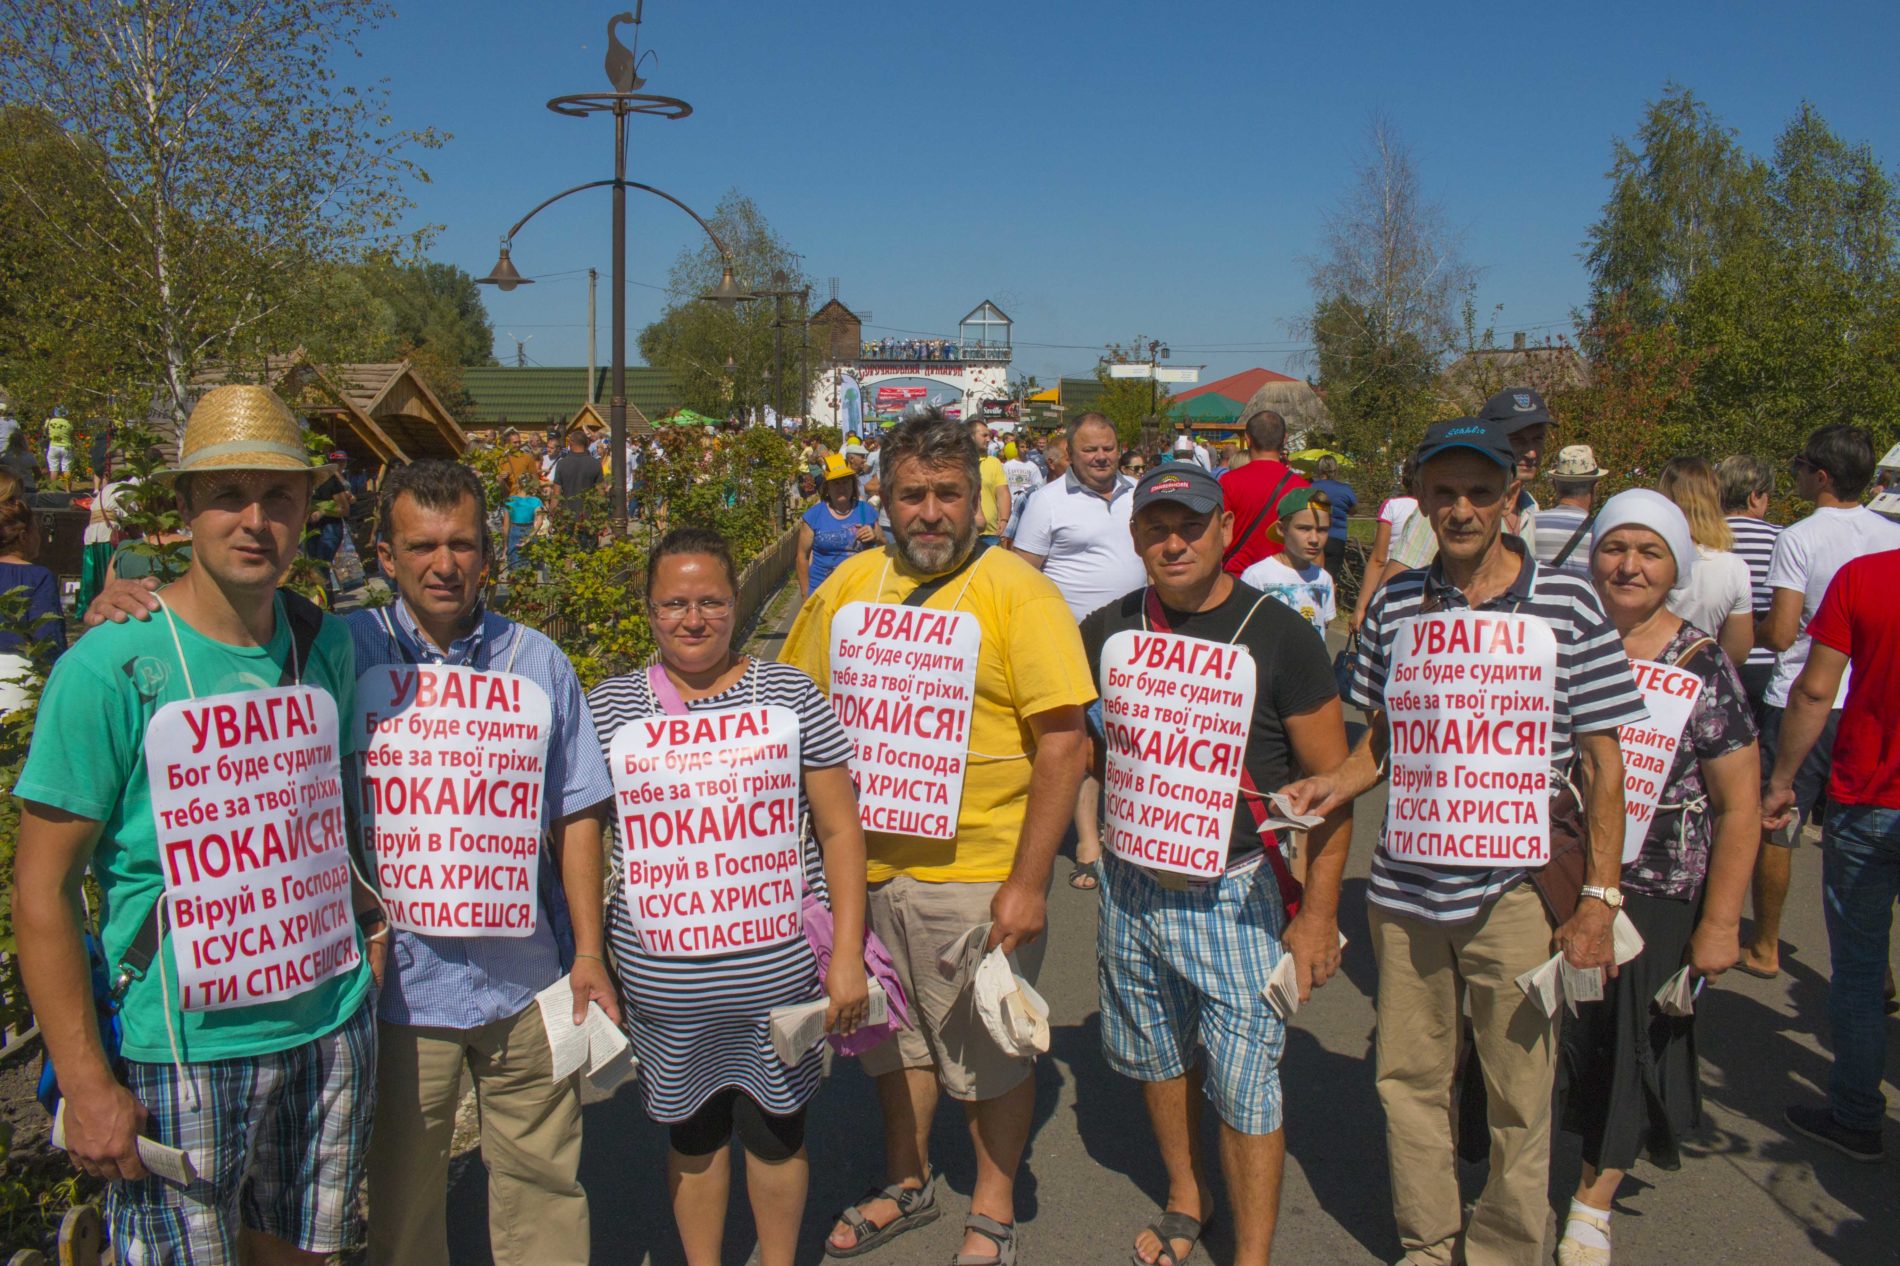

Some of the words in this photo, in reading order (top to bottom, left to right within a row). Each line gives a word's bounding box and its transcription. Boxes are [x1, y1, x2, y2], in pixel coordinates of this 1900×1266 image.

[857, 607, 960, 646] УВАГА!
[1411, 619, 1525, 657] УВАГА!
[839, 639, 860, 659] Бог
[865, 642, 901, 665] буде
[905, 651, 964, 672] судити
[1128, 635, 1238, 681] УВАГА!
[1394, 663, 1419, 682] Бог
[1422, 660, 1464, 685] буде
[1470, 663, 1542, 684] судити
[389, 670, 521, 714] УВАГА!
[833, 669, 858, 687] тебе
[860, 673, 877, 688] за
[881, 674, 913, 693] твої
[916, 678, 969, 702] гріхи.
[1108, 667, 1134, 689] Бог
[1137, 672, 1177, 696] буде
[1180, 683, 1243, 708] судити
[1388, 692, 1420, 711] тебе
[1424, 695, 1440, 710] за
[1445, 689, 1486, 710] твої
[1491, 691, 1550, 715] гріхи.
[182, 693, 318, 753] УВАГА!
[366, 712, 403, 735] Бог
[408, 713, 460, 740] буде
[466, 720, 538, 742] судити
[644, 709, 770, 749] УВАГА!
[832, 693, 965, 743] ПОКАЙСЯ!
[1103, 697, 1129, 716] тебе
[1131, 704, 1149, 719] за
[1154, 706, 1191, 727] твої
[1192, 713, 1246, 738] гріхи.
[1392, 713, 1547, 756] ПОКАЙСЯ!
[167, 763, 211, 790] Бог
[217, 754, 268, 786] буде
[273, 744, 332, 774] судити
[358, 744, 403, 766] тебе
[408, 750, 432, 766] за
[438, 746, 483, 768] твої
[488, 750, 543, 775] гріхи.
[624, 754, 660, 775] Бог
[665, 750, 713, 773] буде
[719, 743, 788, 768] судити
[862, 745, 872, 761] в
[876, 742, 961, 777] Господа
[1104, 721, 1242, 778] ПОКАЙСЯ!
[1620, 748, 1665, 774] тала
[361, 770, 539, 820] ПОКАЙСЯ!
[620, 782, 664, 806] тебе
[669, 783, 691, 800] за
[695, 772, 737, 797] твої
[743, 770, 796, 797] гріхи.
[866, 773, 948, 805] ХРИСТА
[1106, 761, 1133, 792] Віруй
[1135, 777, 1144, 792] в
[1150, 773, 1233, 812] Господа
[1392, 764, 1432, 793] Віруй
[1436, 772, 1448, 787] в
[1454, 765, 1546, 794] Господа
[1624, 765, 1658, 799] ого,
[160, 798, 218, 830] тебе
[224, 795, 250, 817] за
[254, 780, 297, 813] твої
[300, 775, 341, 808] гріхи.
[1138, 803, 1220, 840] ХРИСТА
[1395, 798, 1441, 822] ІСУСА
[1446, 800, 1538, 825] ХРИСТА
[624, 796, 795, 850] ПОКАЙСЯ!
[165, 806, 345, 886] ПОКАЙСЯ!
[364, 827, 421, 858] Віруй
[428, 834, 442, 851] в
[450, 827, 537, 859] Господа
[1115, 829, 1225, 875] СПАСЕШСЯ.
[1394, 831, 1413, 854] ТИ
[1417, 832, 1549, 860] СПАСЕШСЯ.
[440, 864, 529, 891] ХРИСТА
[629, 857, 689, 889] Віруй
[696, 861, 708, 879] в
[714, 848, 798, 877] Господа
[175, 885, 256, 931] Віруй
[262, 887, 276, 909] в
[281, 863, 349, 906] Господа
[408, 902, 536, 929] СПАСЕШСЯ.
[638, 891, 705, 919] ІСУСА
[710, 878, 794, 914] ХРИСТА
[192, 924, 276, 969] ІСУСА
[282, 901, 348, 948] ХРИСТА
[646, 927, 674, 952] ТИ
[199, 975, 238, 1008] ТИ
[245, 936, 359, 997] СПАСЕШСЯ.
